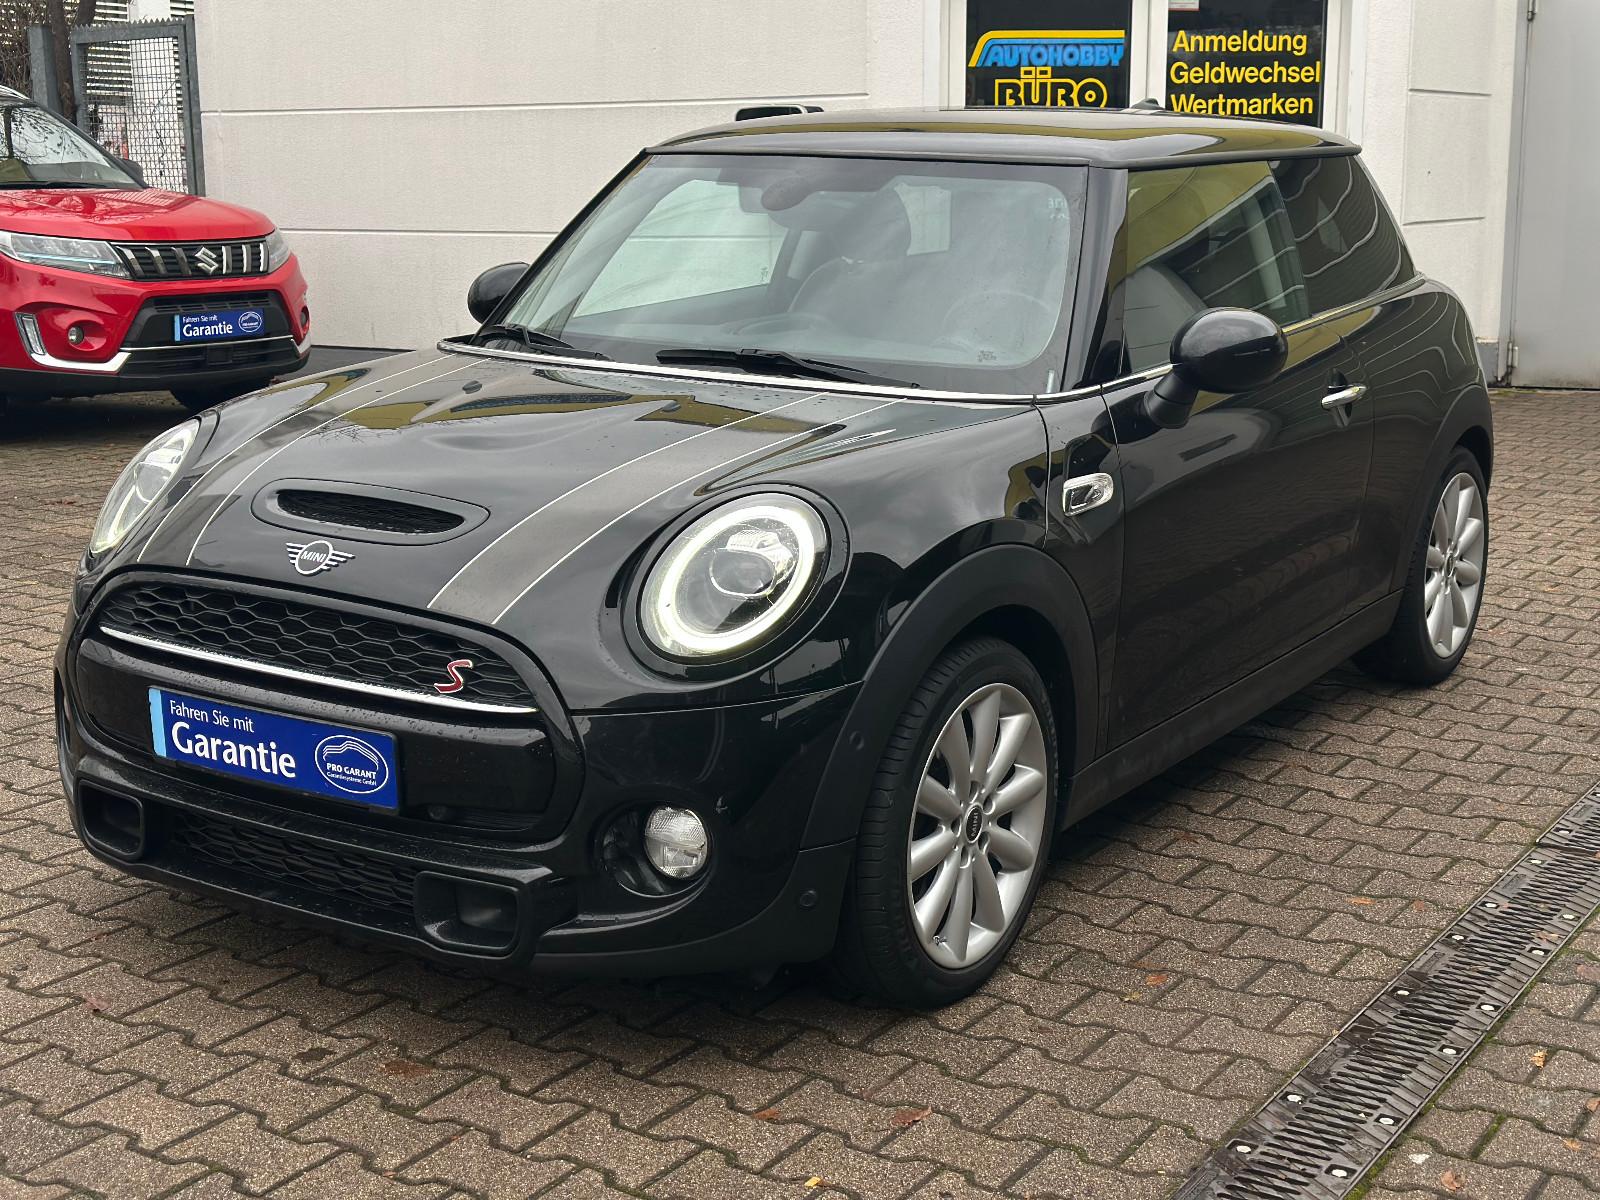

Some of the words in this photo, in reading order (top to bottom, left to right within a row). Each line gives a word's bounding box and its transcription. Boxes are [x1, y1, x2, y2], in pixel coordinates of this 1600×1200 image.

[1172, 30, 1308, 56] Anmeldung
[984, 44, 1125, 67] AUTOHOBBY
[1169, 60, 1321, 84] Geldwechsel
[994, 66, 1108, 108] BÜRO
[1170, 92, 1314, 116] Wertmarken
[182, 321, 233, 337] Garantie
[300, 550, 327, 563] MINI
[433, 659, 473, 694] S
[169, 699, 209, 723] Fahren
[212, 709, 230, 728] Sie
[233, 716, 255, 733] mit
[171, 721, 296, 778] Garantie
[326, 762, 343, 773] PRO
[343, 766, 377, 780] GARANT
